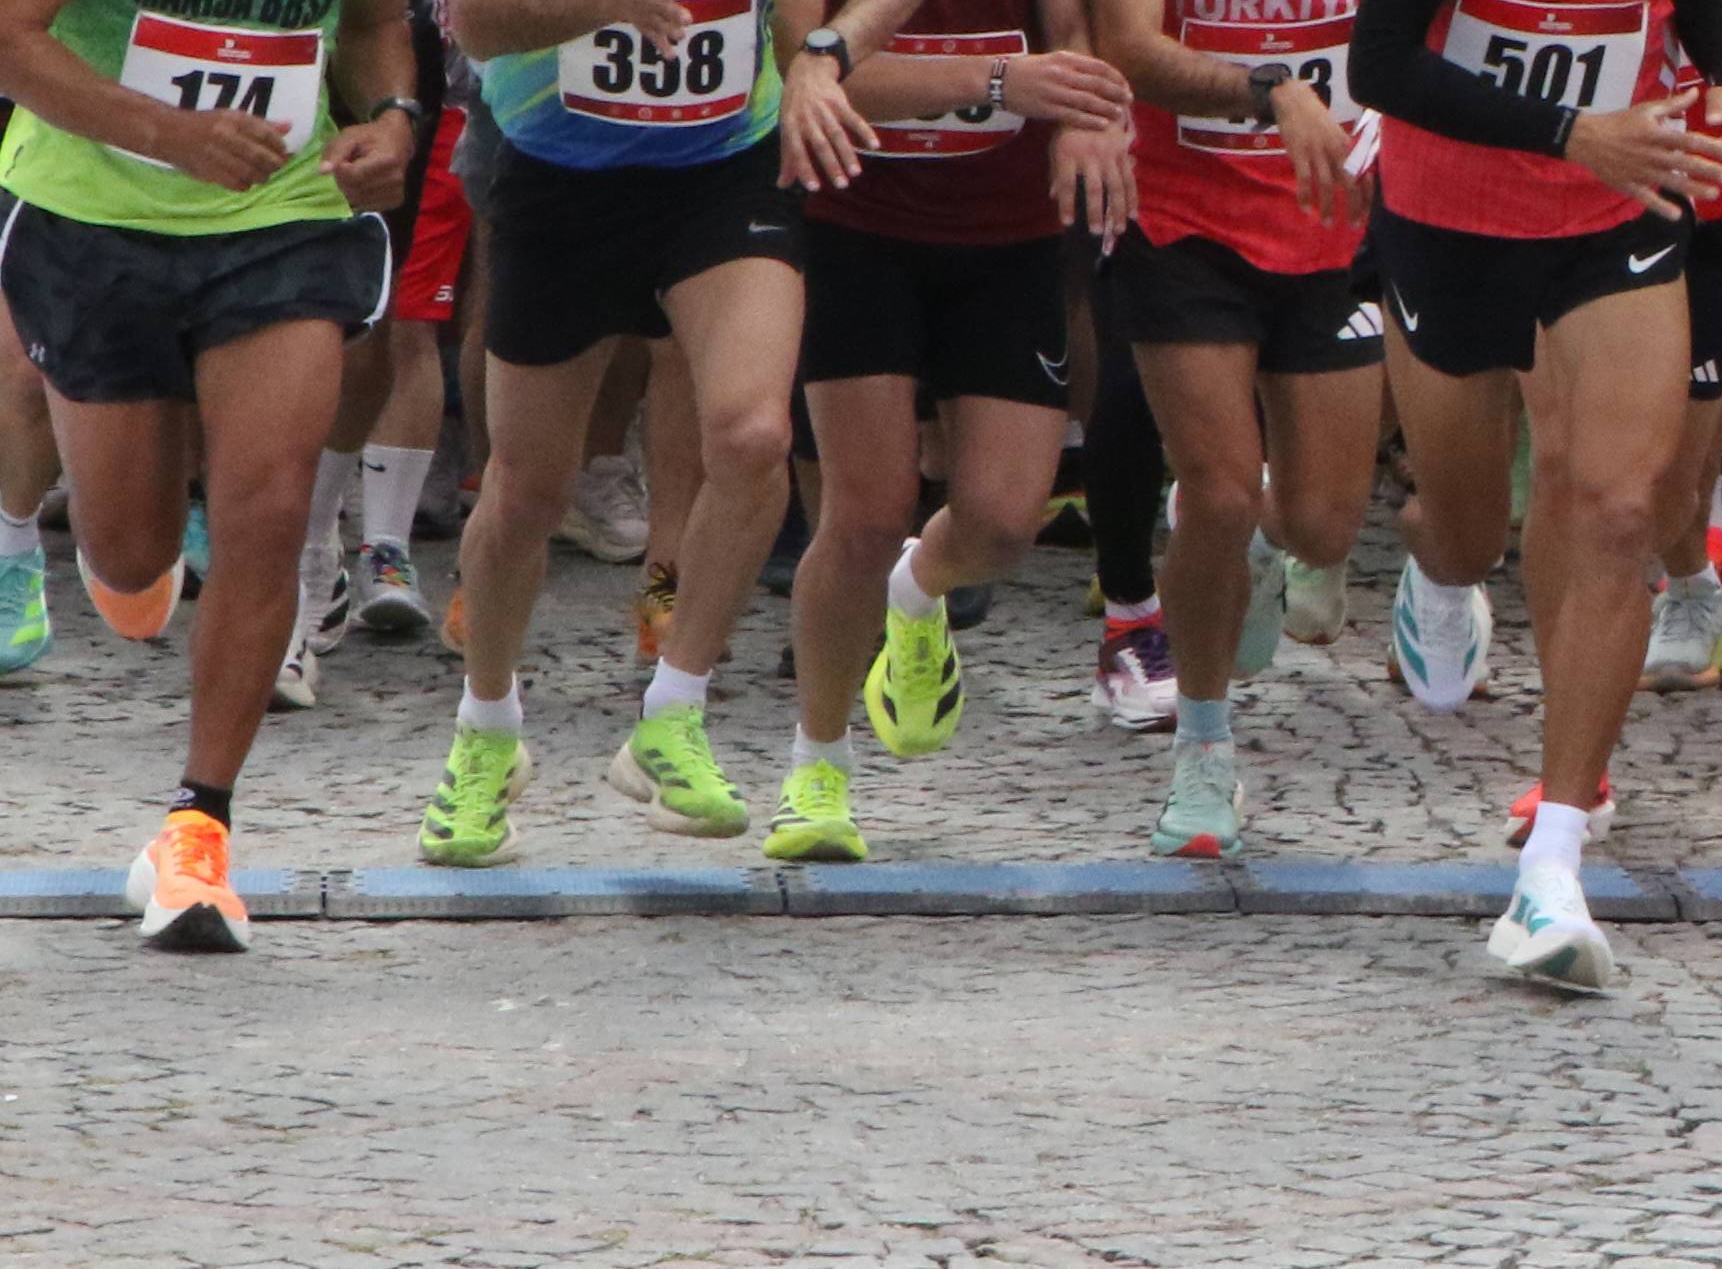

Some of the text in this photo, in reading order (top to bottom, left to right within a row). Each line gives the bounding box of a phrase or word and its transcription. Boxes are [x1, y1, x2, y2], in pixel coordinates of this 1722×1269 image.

[171, 70, 275, 119] 174
[592, 29, 724, 98] 358
[1479, 34, 1606, 107] 501
